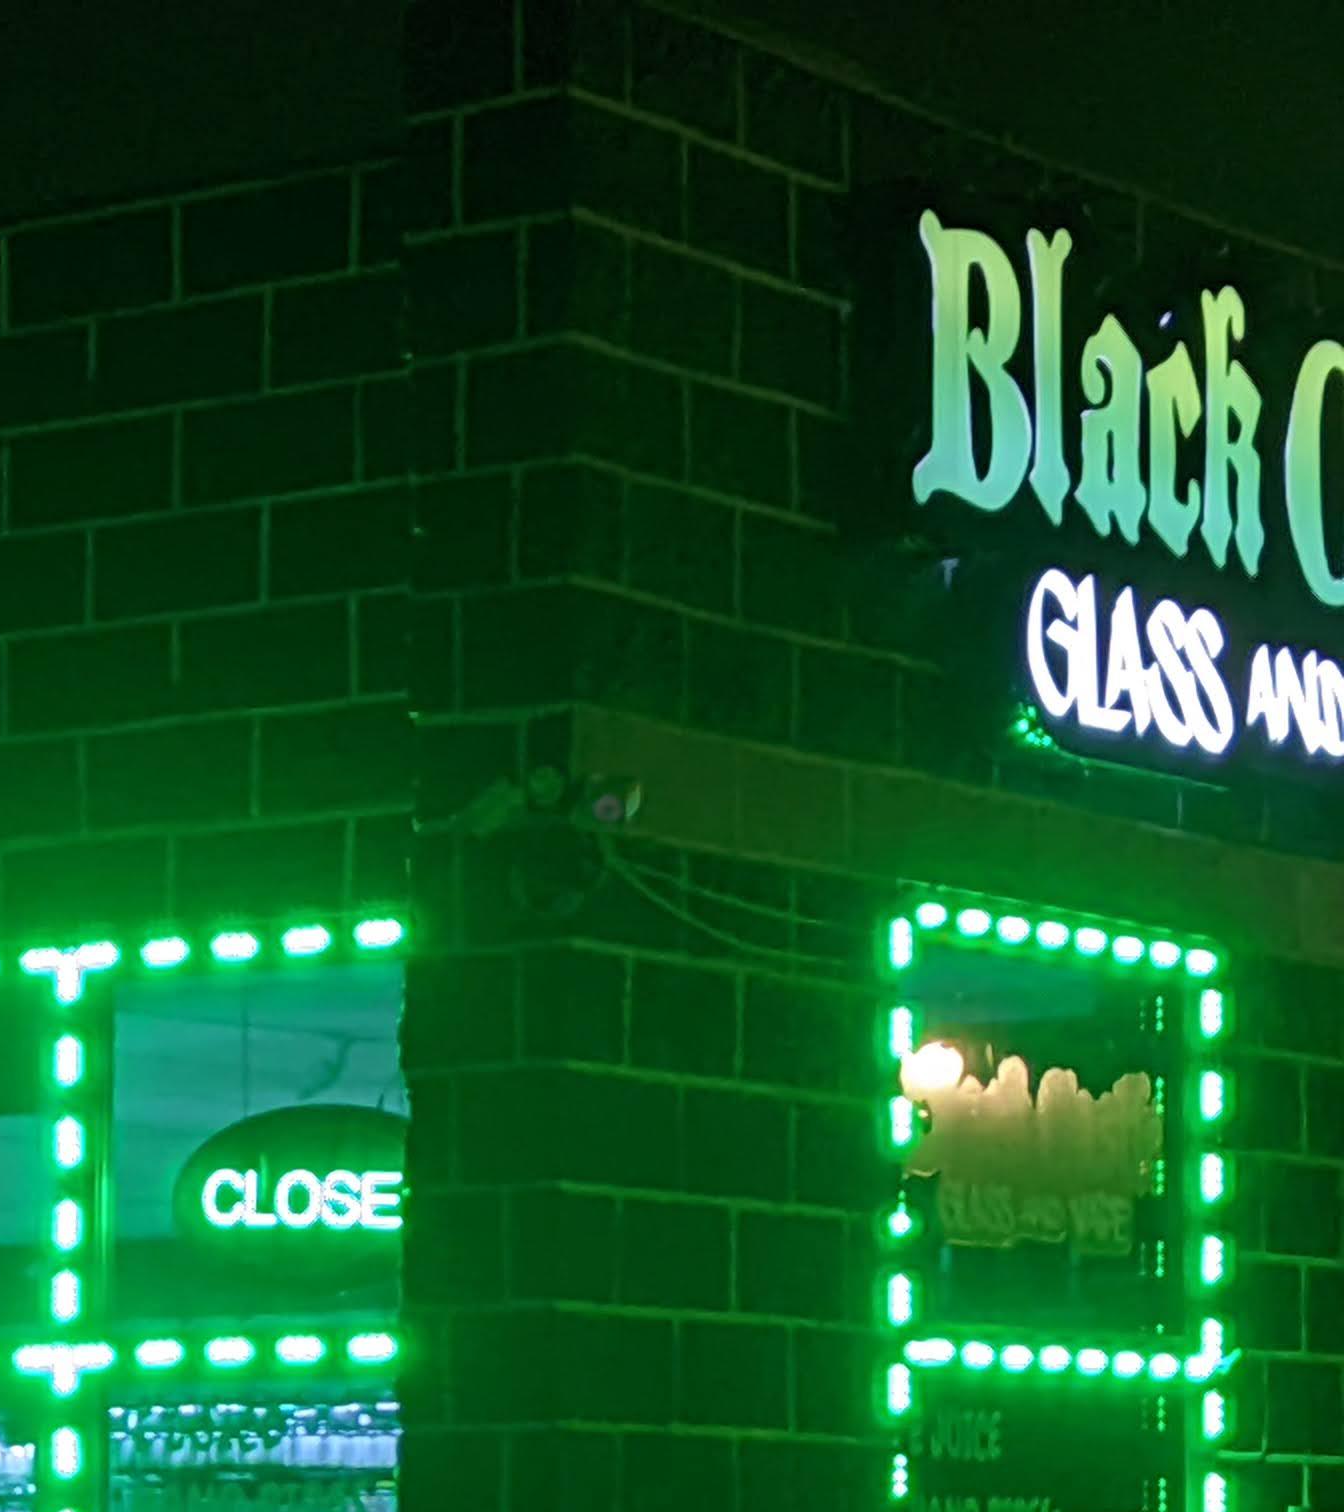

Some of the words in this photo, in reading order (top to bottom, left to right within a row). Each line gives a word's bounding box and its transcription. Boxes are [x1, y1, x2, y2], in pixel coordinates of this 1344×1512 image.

[912, 208, 1266, 579] Black
[1026, 567, 1236, 756] GLASS
[929, 1409, 1004, 1461] JUICE
